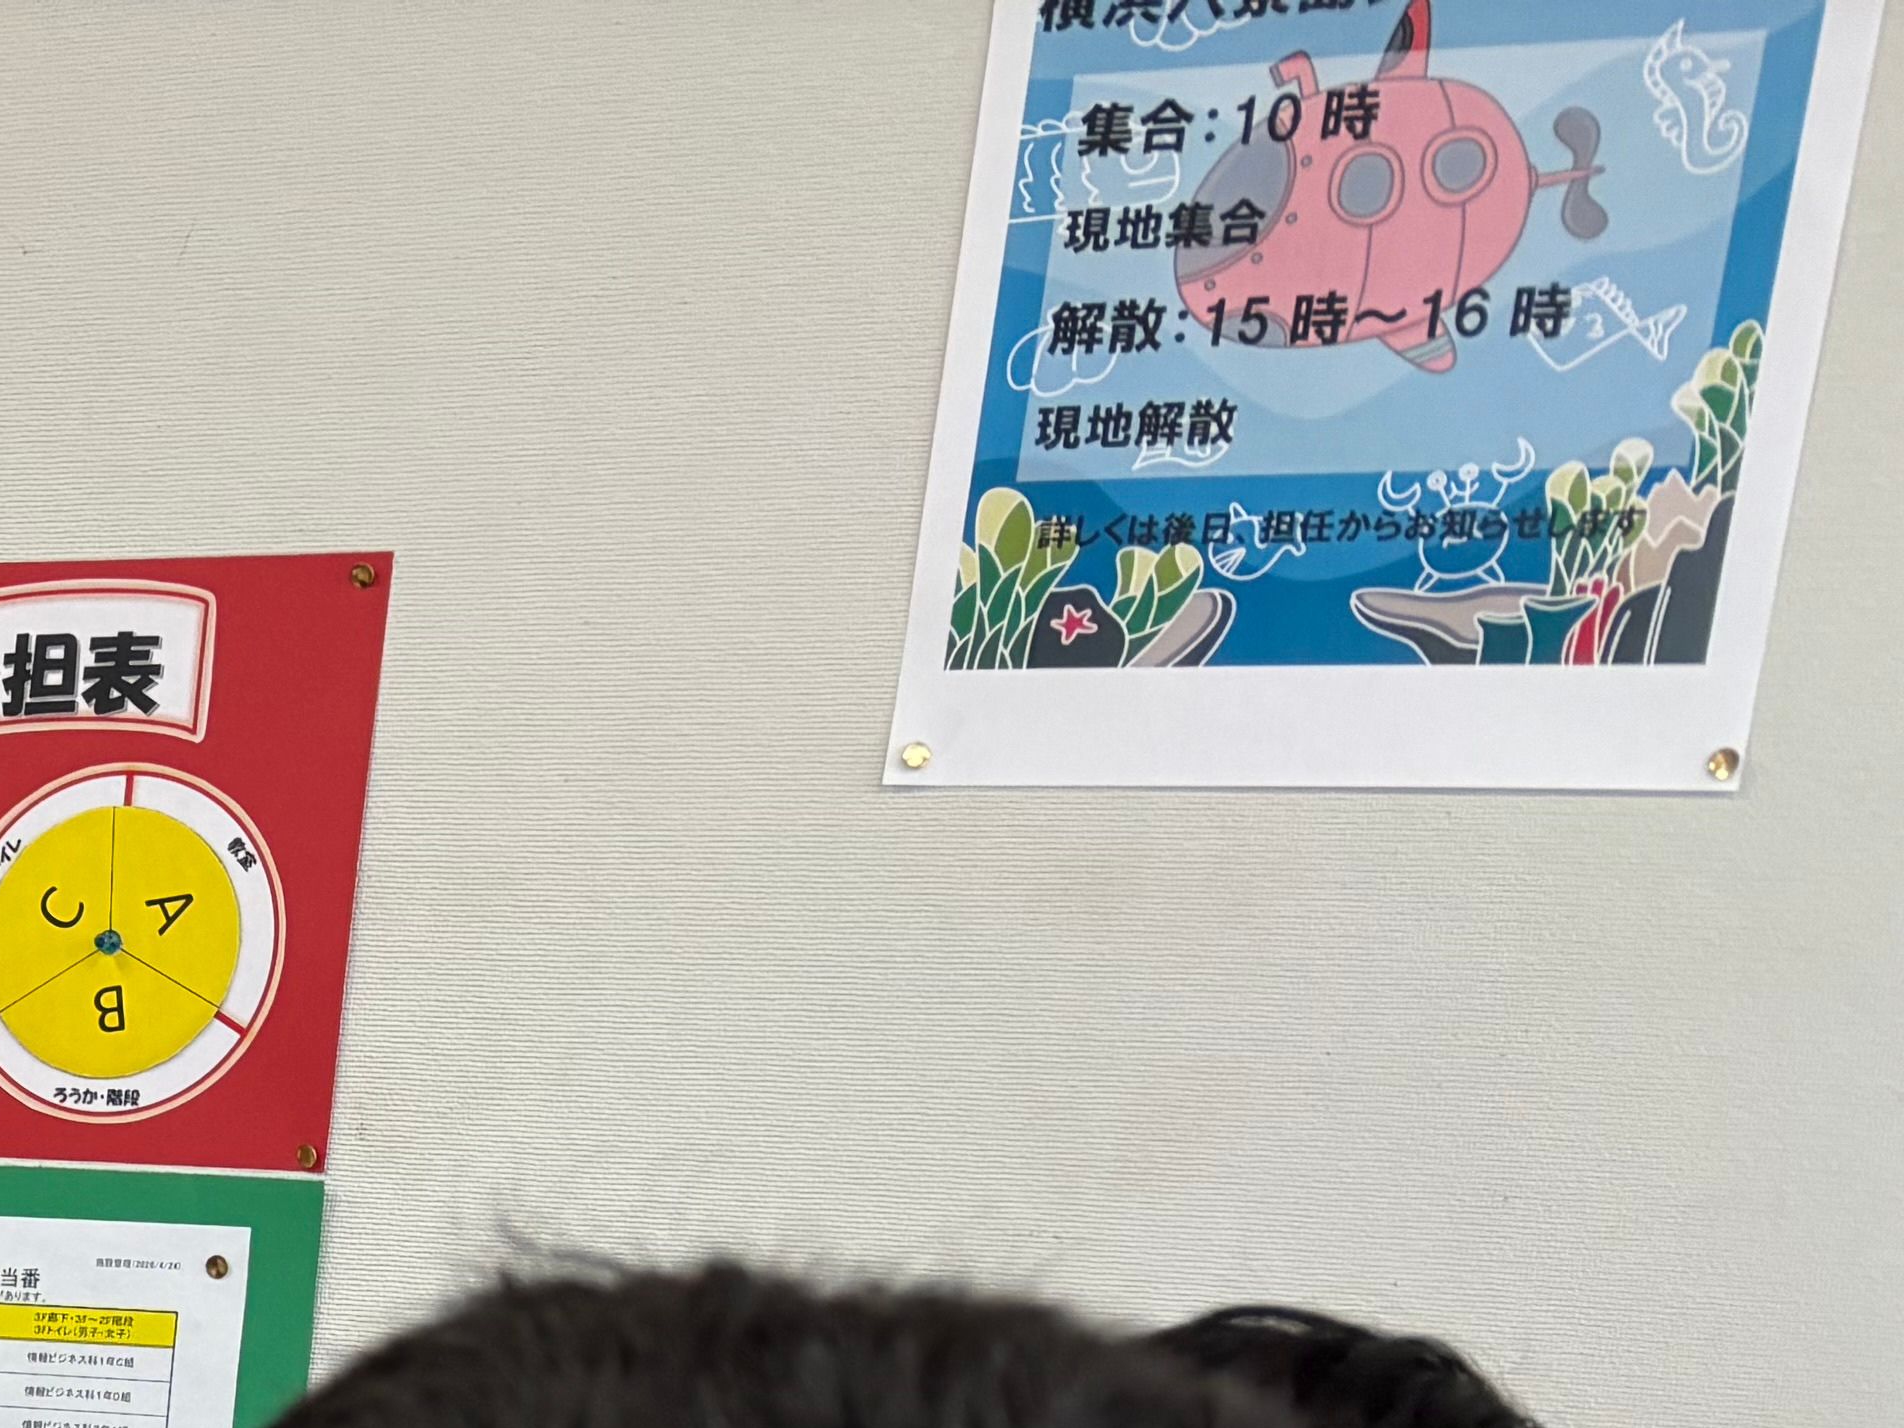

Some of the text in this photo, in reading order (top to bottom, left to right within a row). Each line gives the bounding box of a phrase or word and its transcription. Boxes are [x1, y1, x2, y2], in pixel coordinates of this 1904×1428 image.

[1064, 199, 1266, 254] 現地集合
[1034, 398, 1238, 451] 現地解散
[41, 886, 84, 928] C
[145, 894, 193, 936] A
[94, 985, 125, 1032] B
[53, 1088, 140, 1106] ろうか・階段
